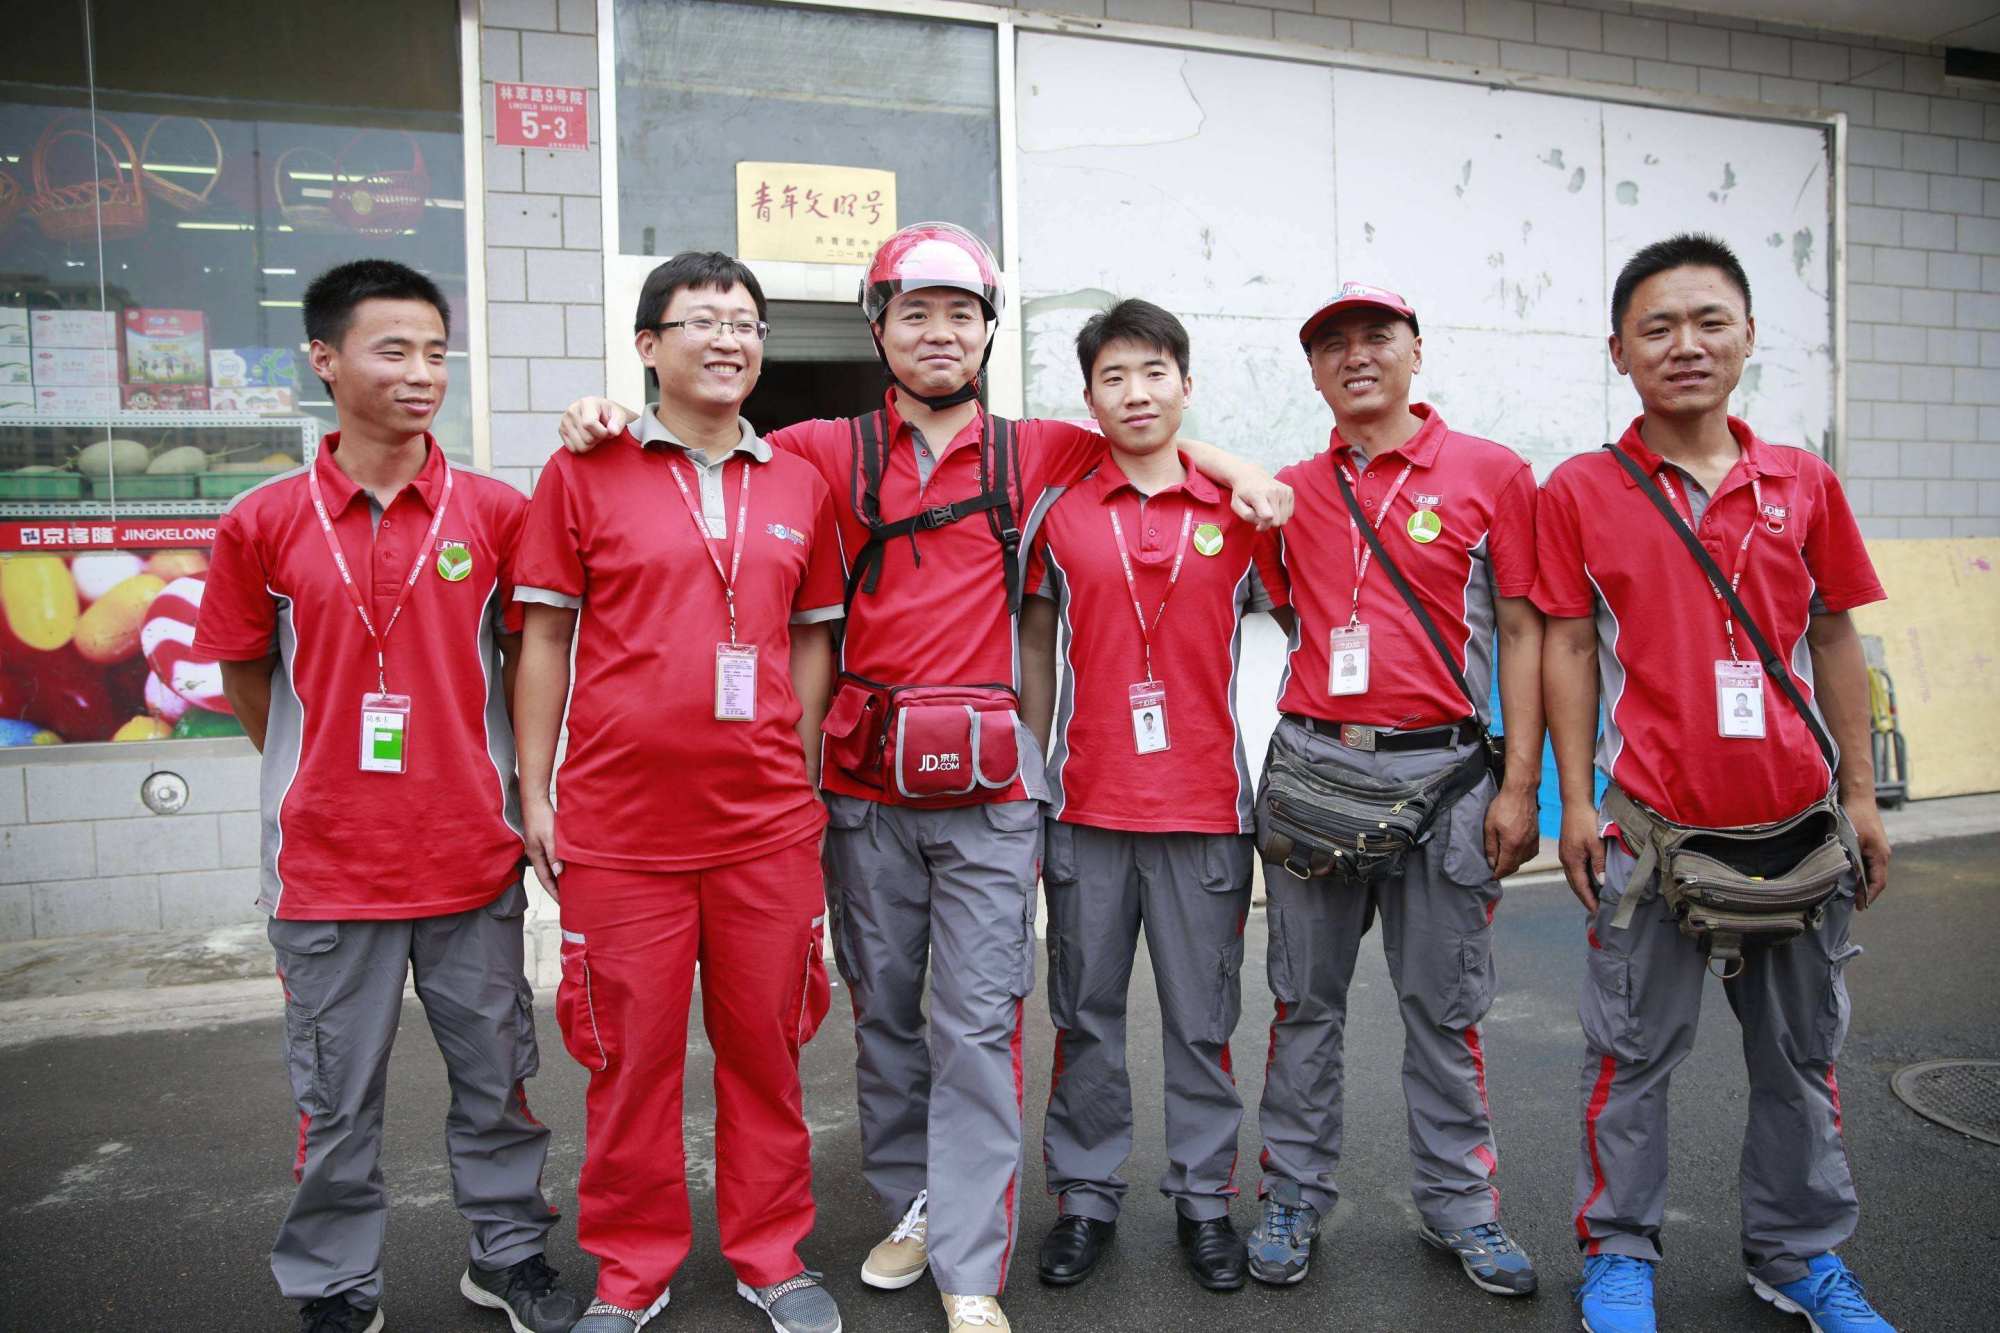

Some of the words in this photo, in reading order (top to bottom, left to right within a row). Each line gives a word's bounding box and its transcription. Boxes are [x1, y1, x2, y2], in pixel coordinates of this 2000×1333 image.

[521, 111, 567, 140] 5-3
[752, 181, 883, 225] 青年文明号
